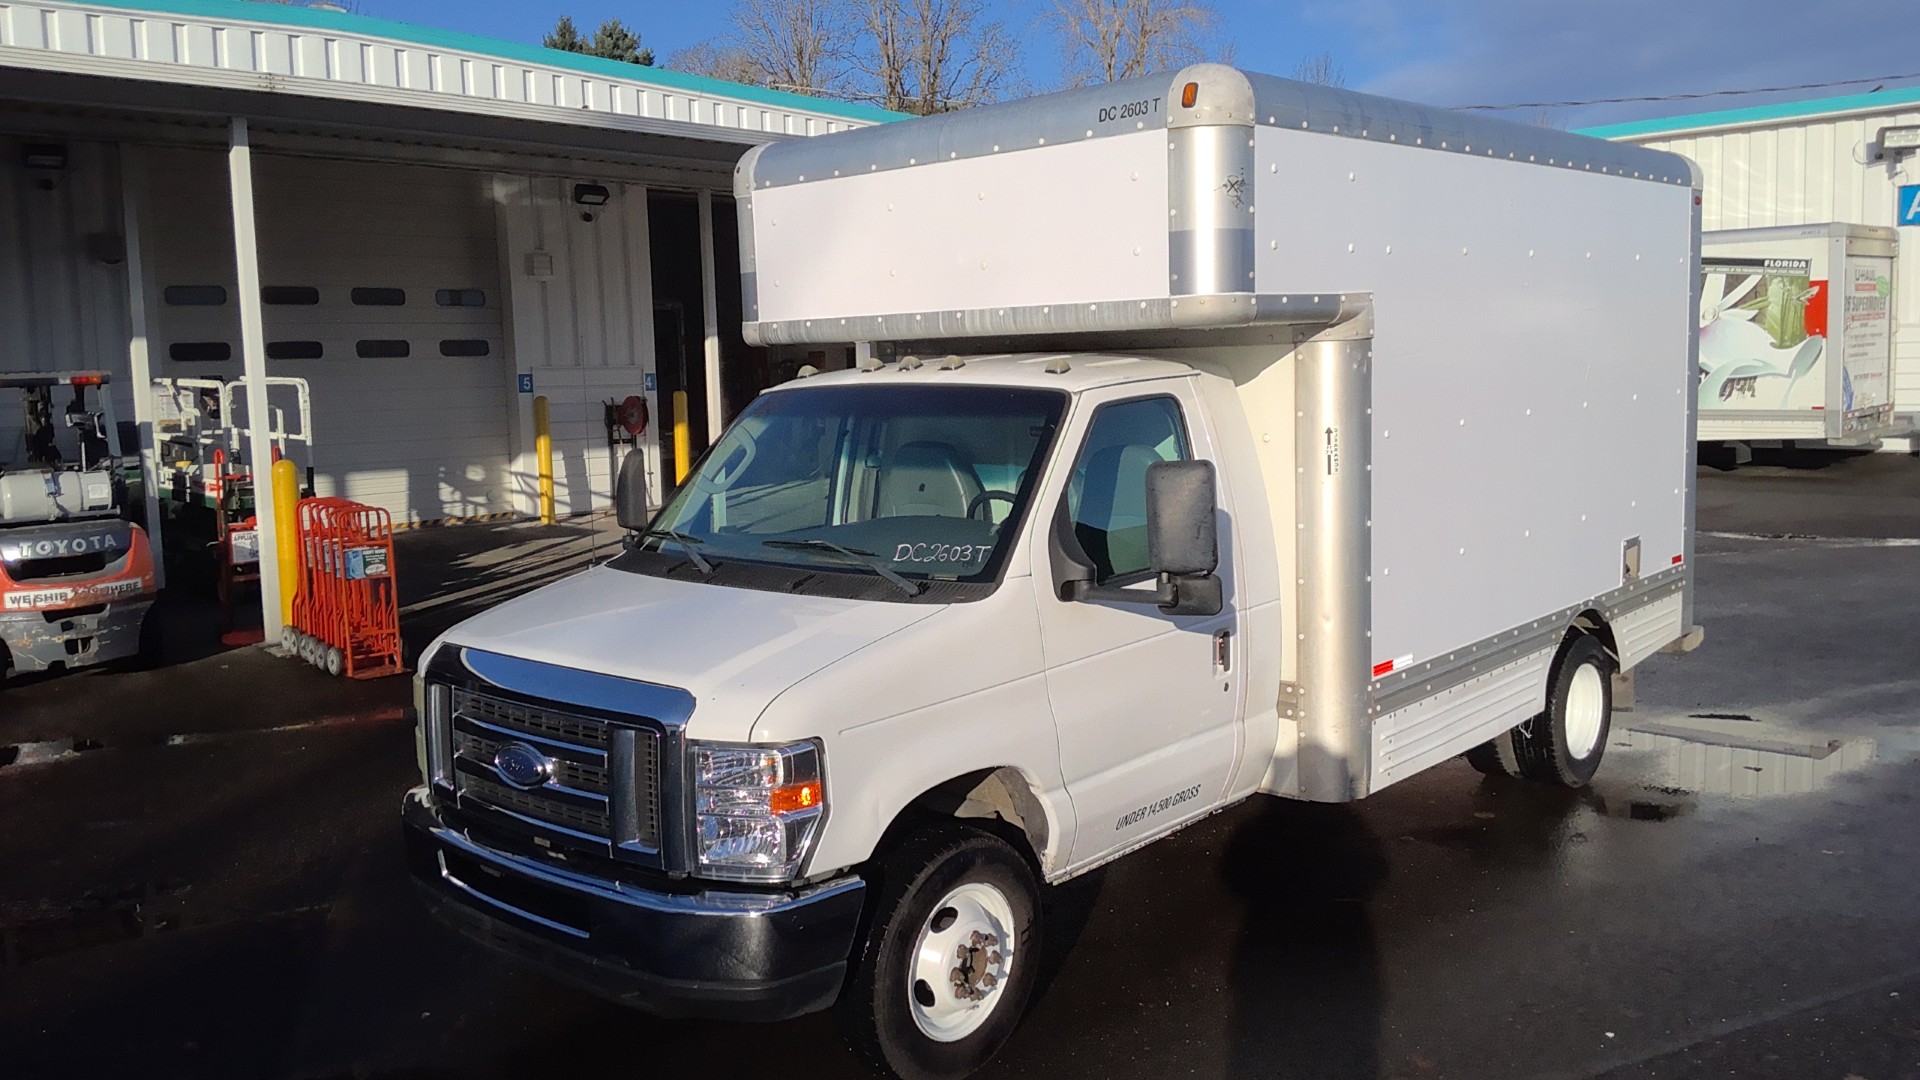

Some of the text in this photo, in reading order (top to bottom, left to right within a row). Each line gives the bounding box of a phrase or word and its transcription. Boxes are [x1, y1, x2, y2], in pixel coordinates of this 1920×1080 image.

[1098, 97, 1161, 122] DC 2603 T
[1764, 259, 1807, 268] FLORIDA
[523, 377, 531, 390] 5
[645, 376, 652, 387] 4
[20, 534, 117, 557] TOYOTA
[10, 595, 31, 605] WE
[1115, 806, 1147, 831] UNDER
[1172, 784, 1201, 806] GROSS
